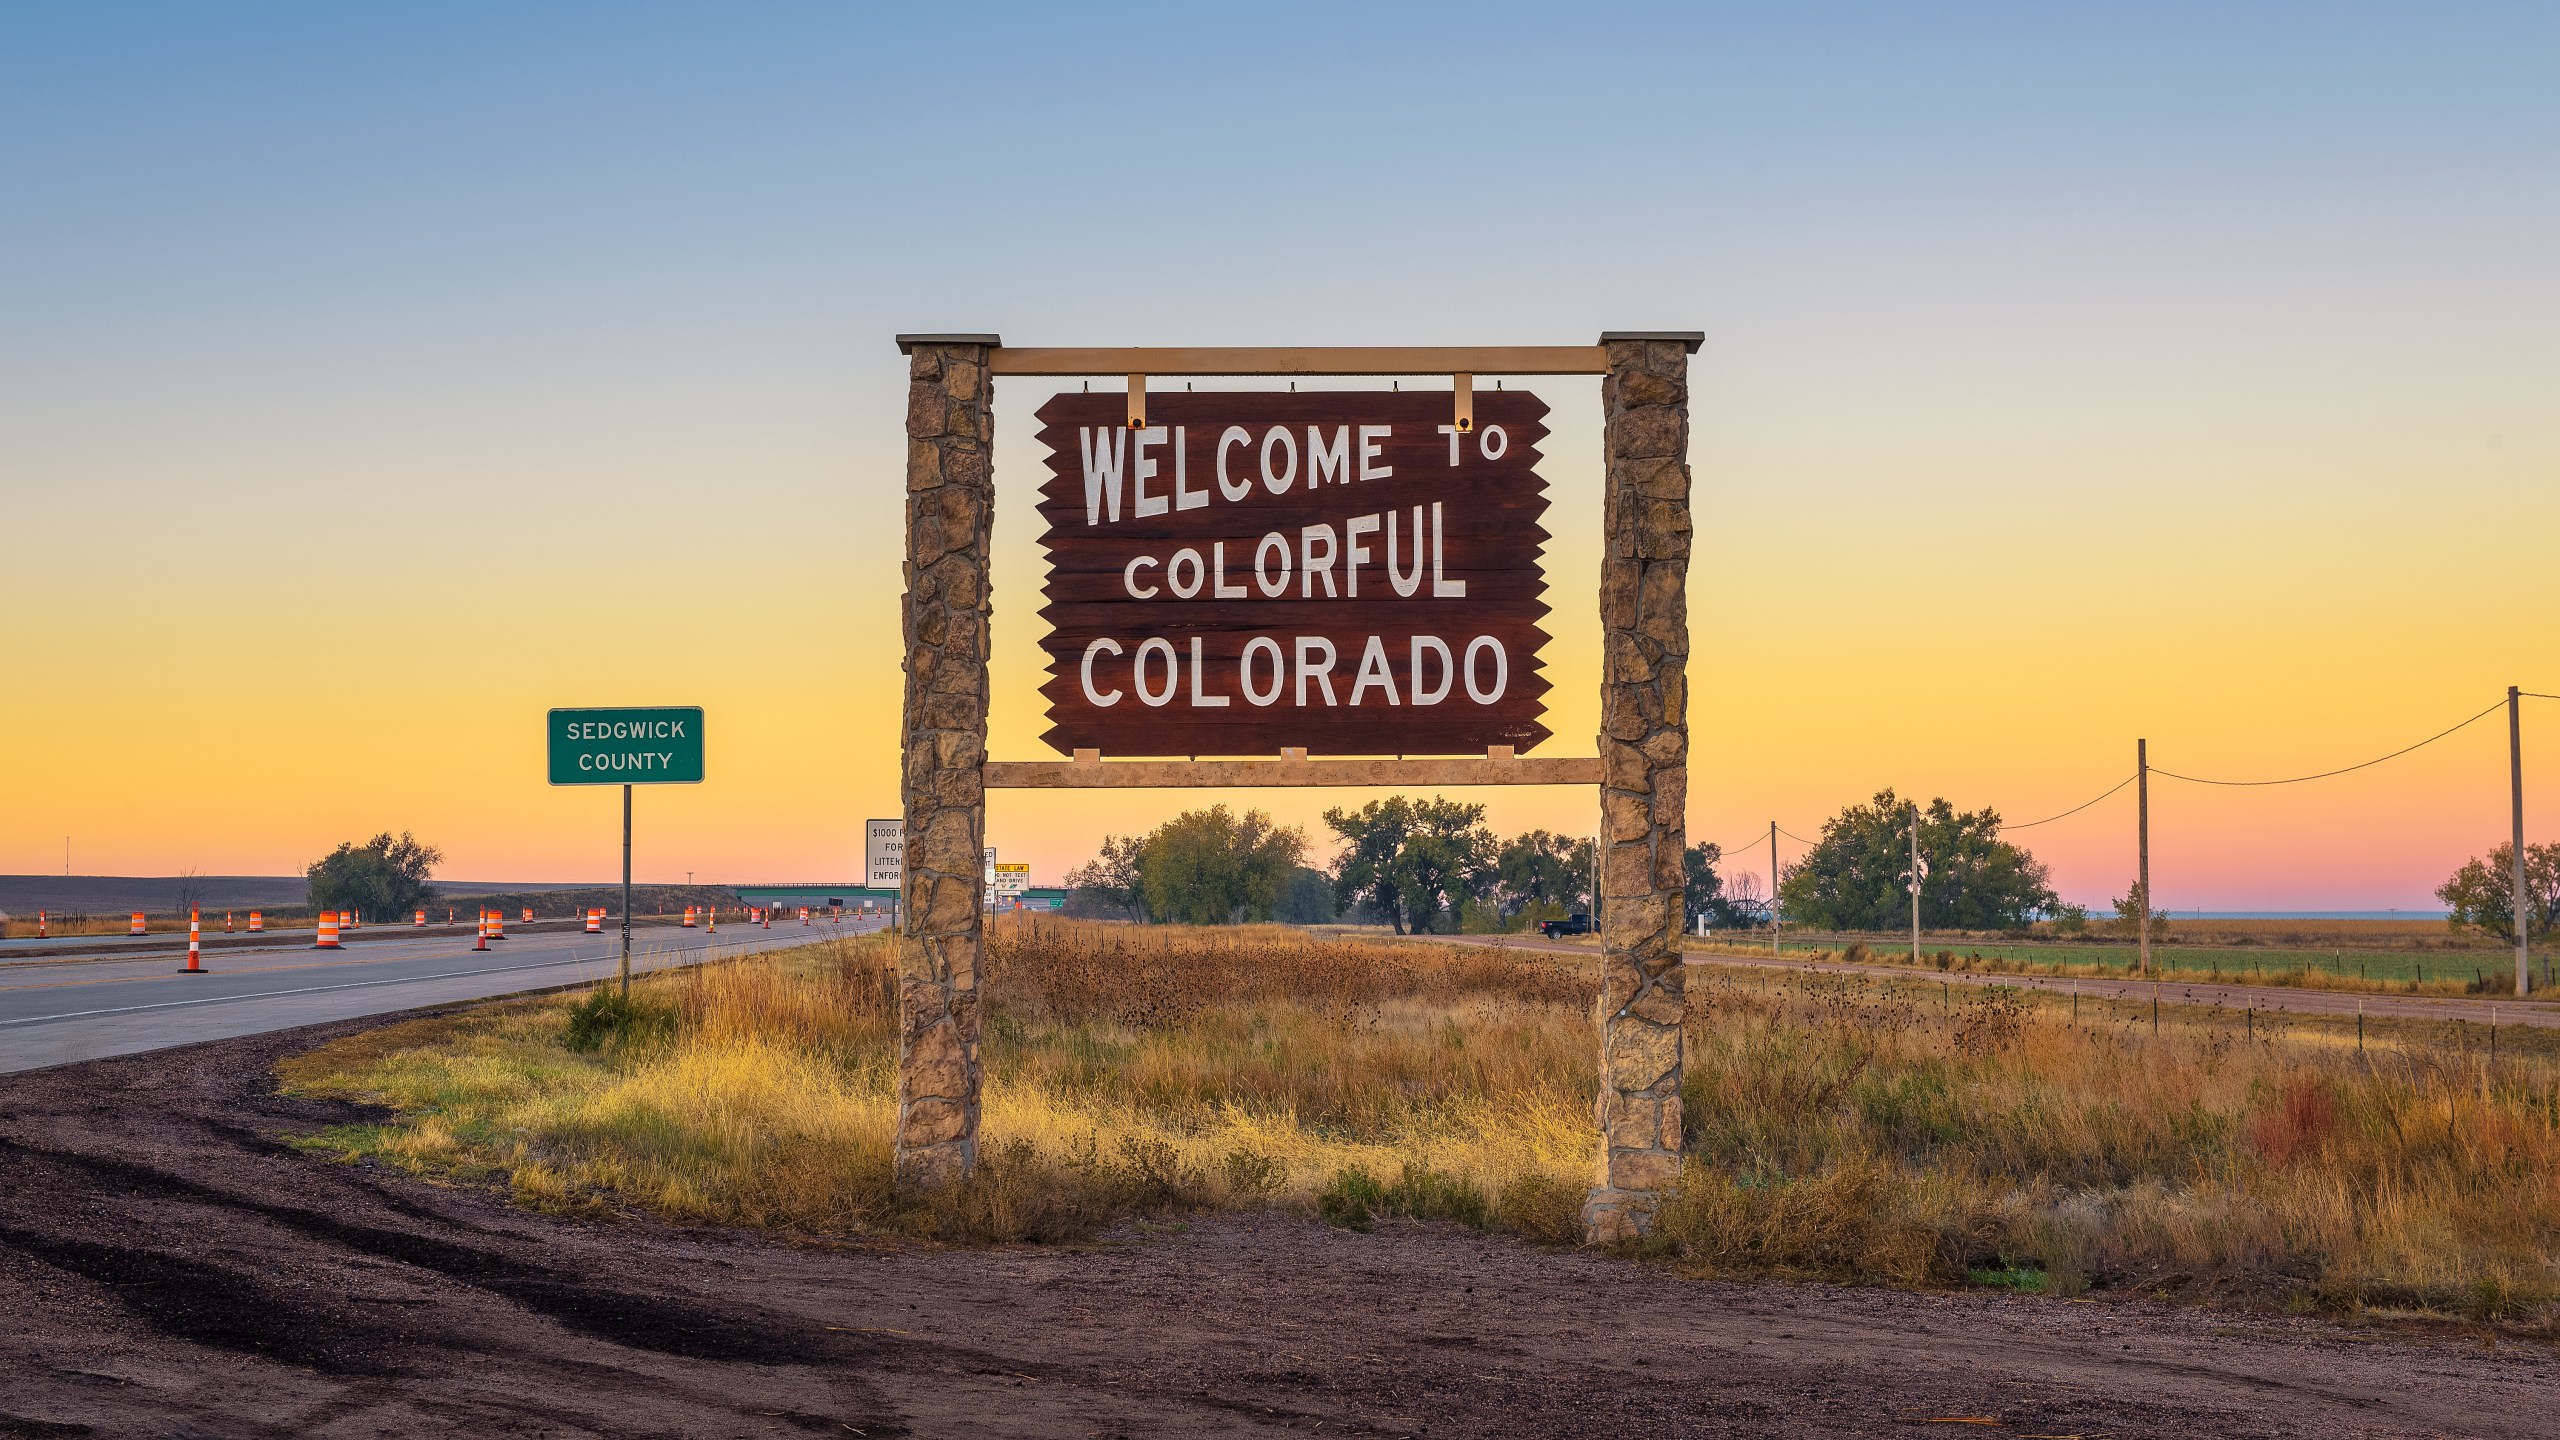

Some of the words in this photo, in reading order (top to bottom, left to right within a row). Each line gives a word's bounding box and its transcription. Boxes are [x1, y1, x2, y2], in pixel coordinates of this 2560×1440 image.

[1080, 425, 1392, 526] WELCOME
[1437, 425, 1507, 466] TO
[1124, 501, 1466, 599] COLORFUL
[1080, 635, 1507, 707] COLORADO
[566, 721, 686, 740] SEDGWICK
[578, 752, 673, 771] COUNTY
[873, 828, 896, 837] $1000
[885, 843, 903, 851] FOR
